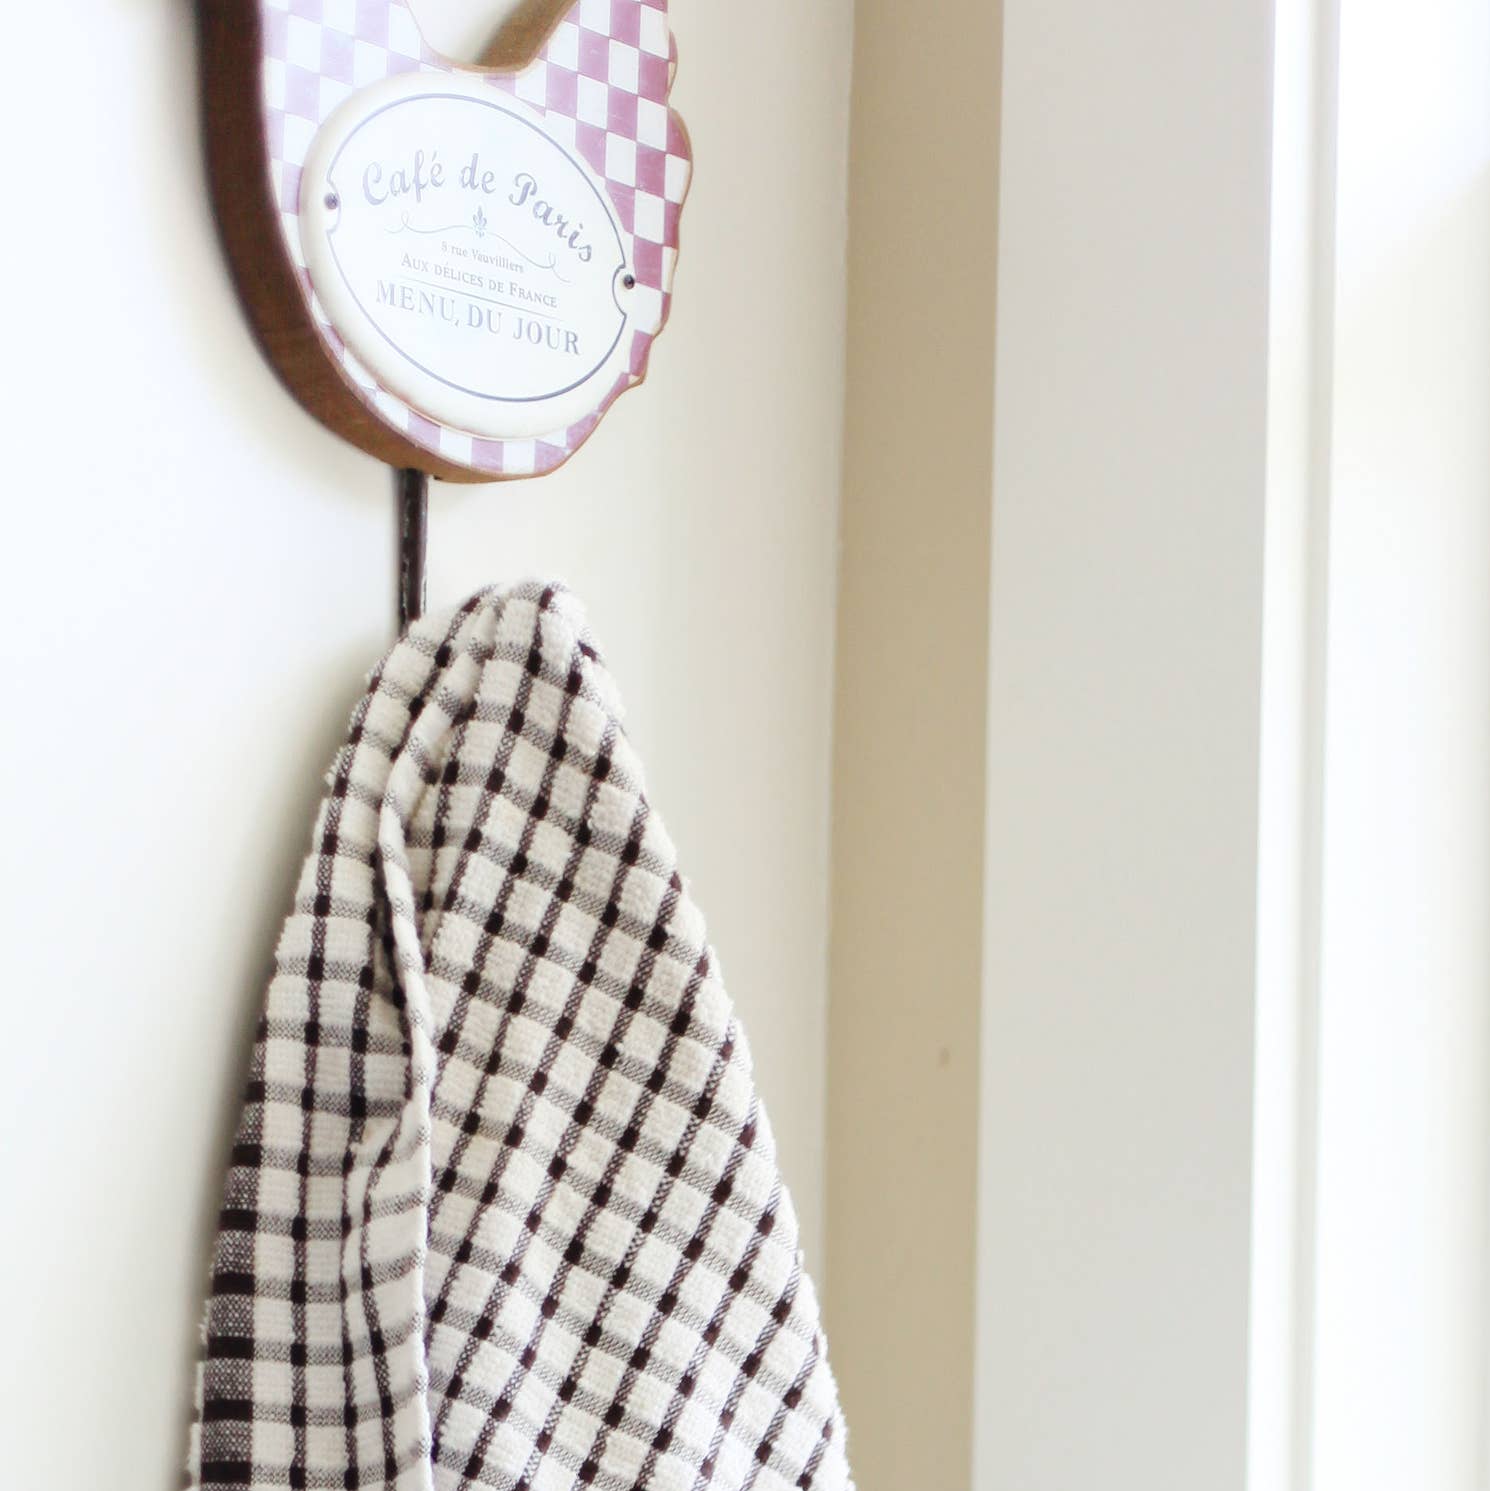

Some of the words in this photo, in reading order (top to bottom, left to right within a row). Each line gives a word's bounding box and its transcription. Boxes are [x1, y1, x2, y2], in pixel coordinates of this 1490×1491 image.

[362, 149, 446, 206] Café
[460, 153, 496, 194] de
[508, 172, 593, 262] Paris
[451, 245, 469, 258] rue
[466, 303, 503, 335] DU
[512, 317, 582, 356] JOUR
